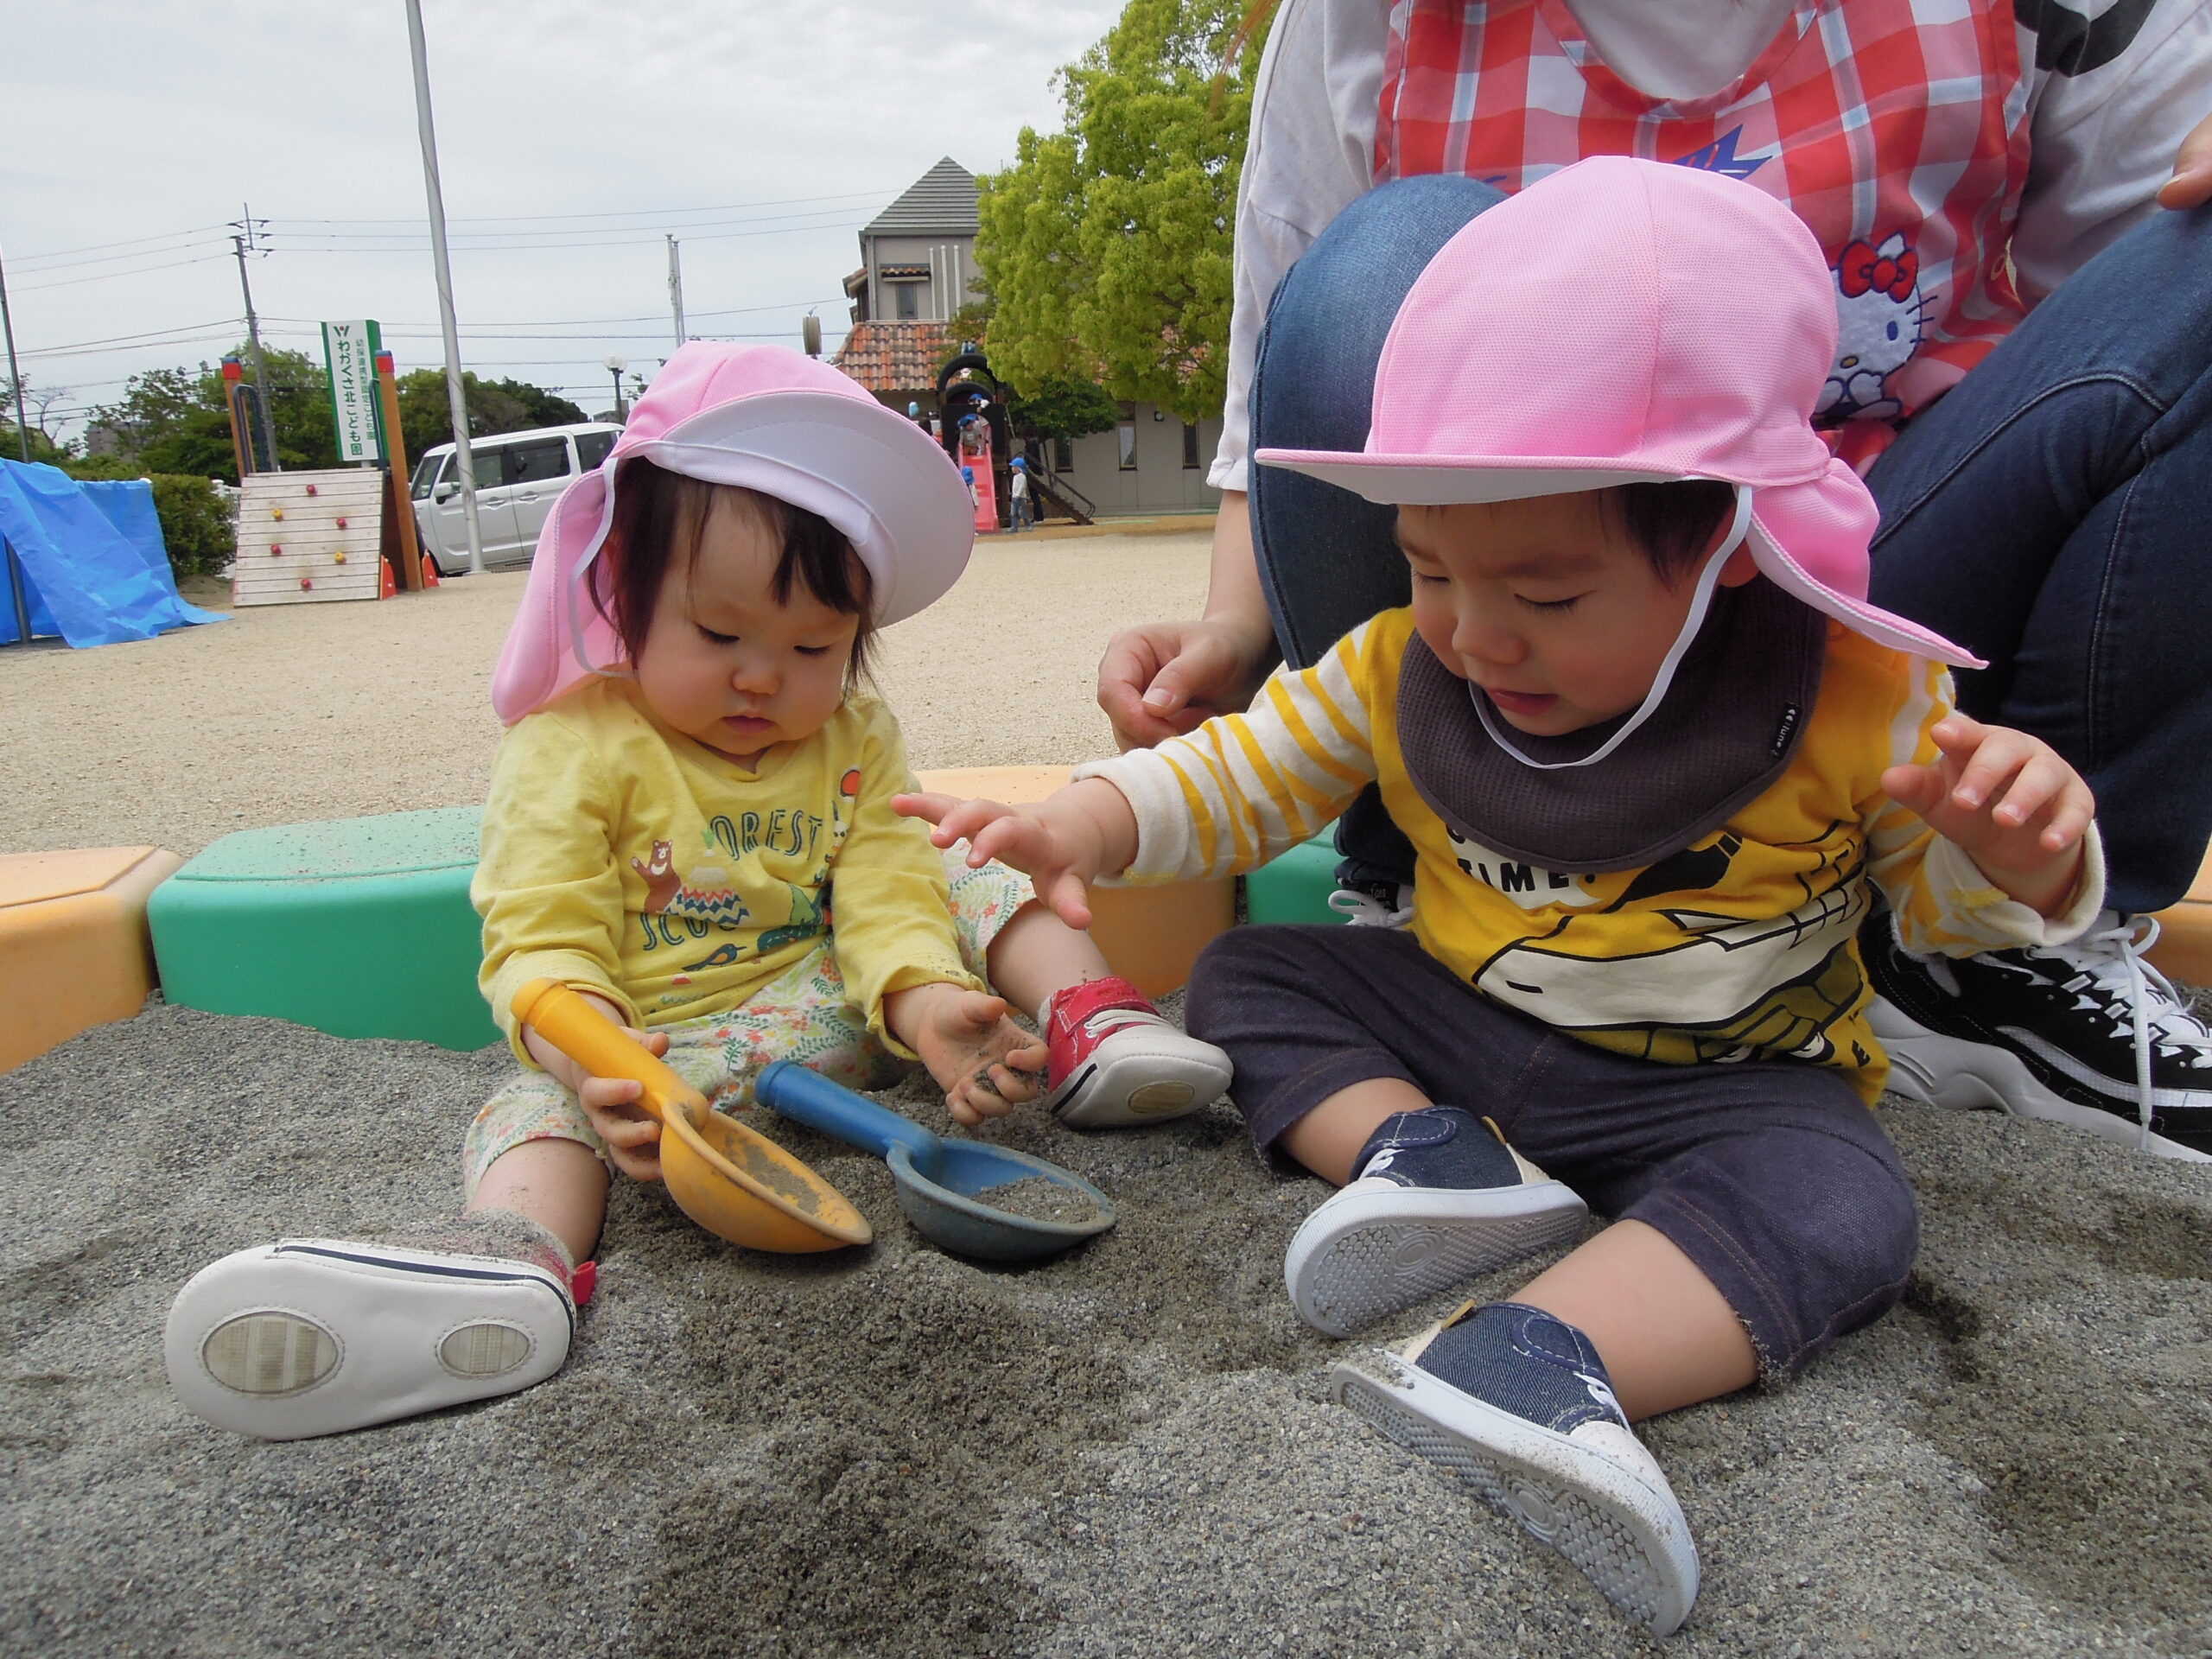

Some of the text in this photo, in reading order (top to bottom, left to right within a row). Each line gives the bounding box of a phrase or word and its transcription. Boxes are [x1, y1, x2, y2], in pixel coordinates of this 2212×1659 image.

[337, 340, 362, 455] わかくさ北こども園
